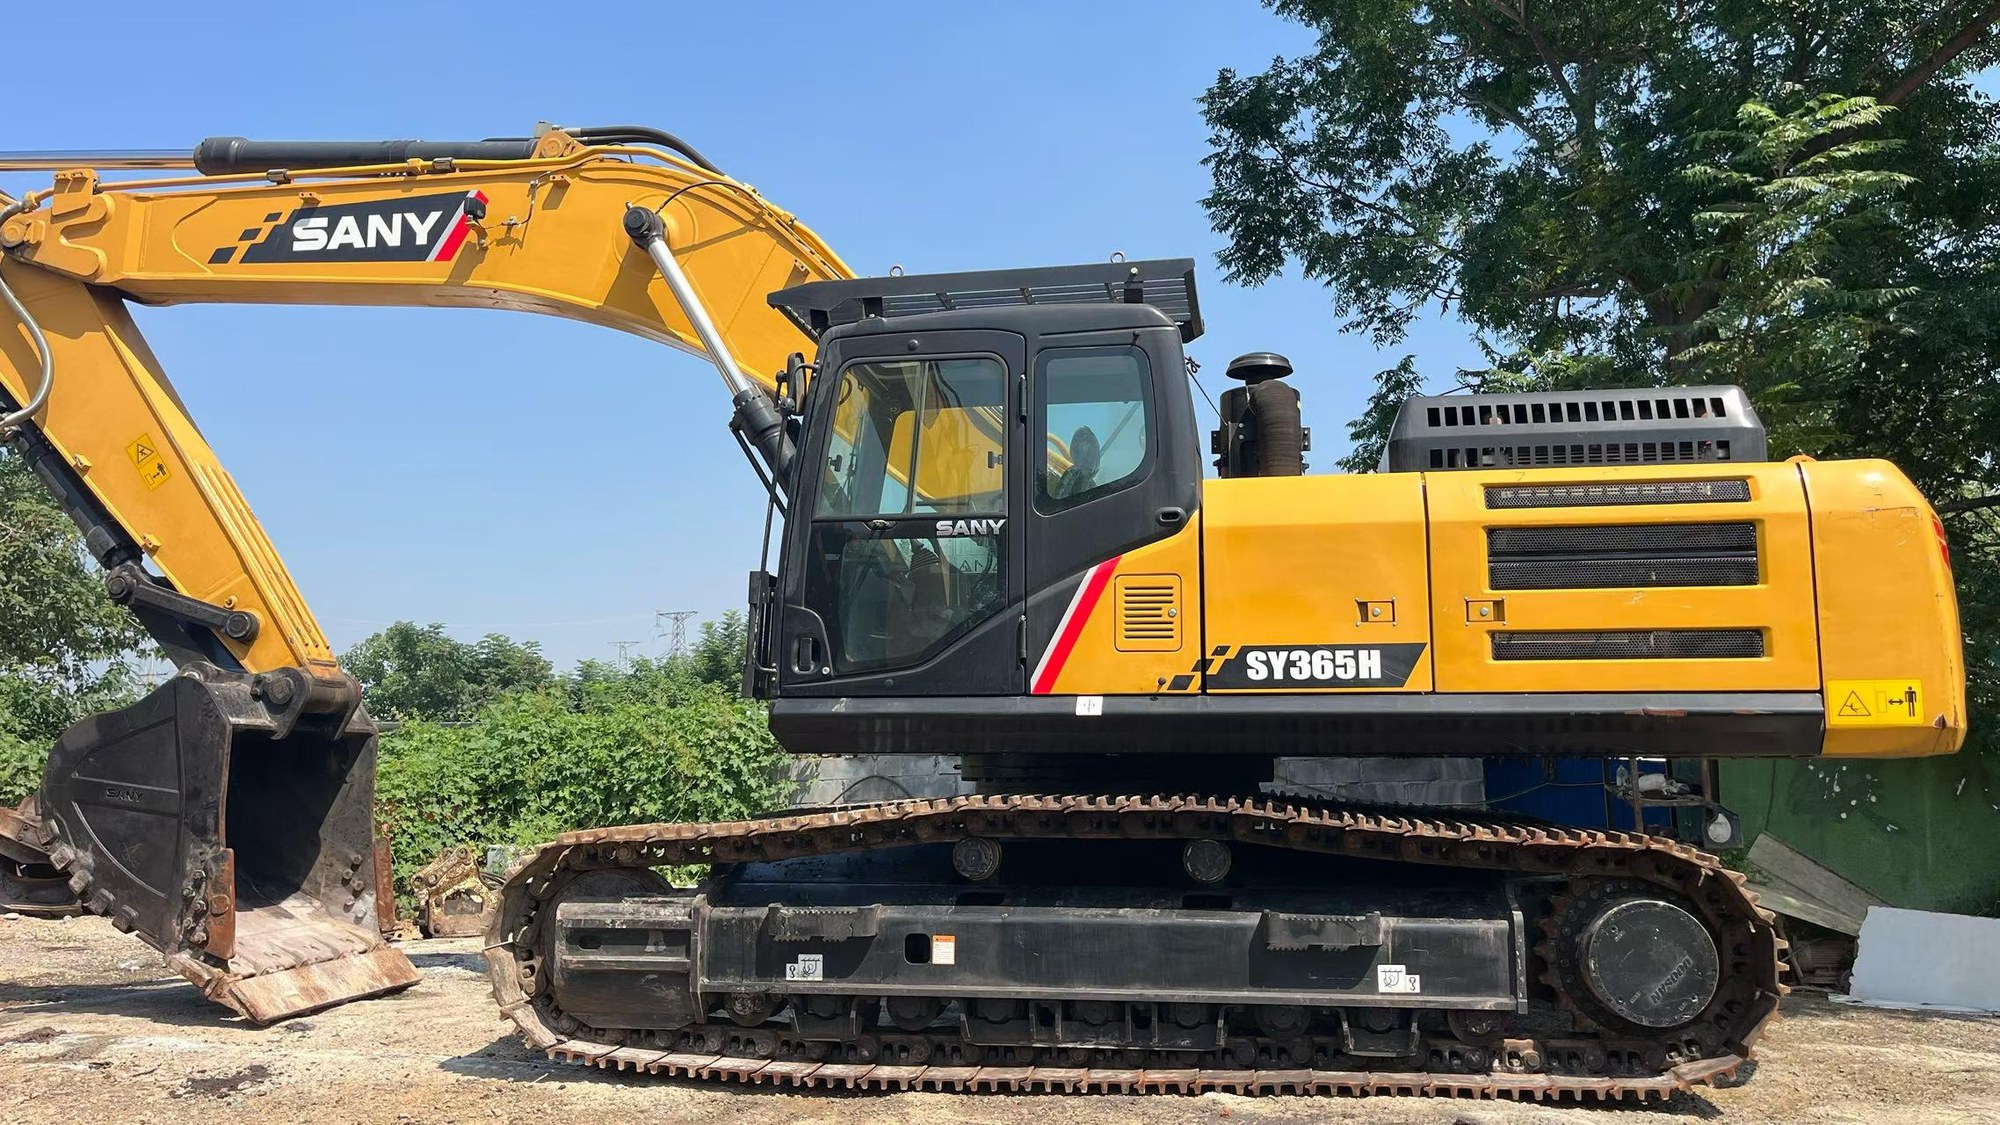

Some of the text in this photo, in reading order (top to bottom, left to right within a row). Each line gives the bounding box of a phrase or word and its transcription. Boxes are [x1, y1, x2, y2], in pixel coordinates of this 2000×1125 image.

[292, 211, 443, 251] SANY
[936, 519, 1006, 536] SANY
[1246, 650, 1382, 680] SY365H
